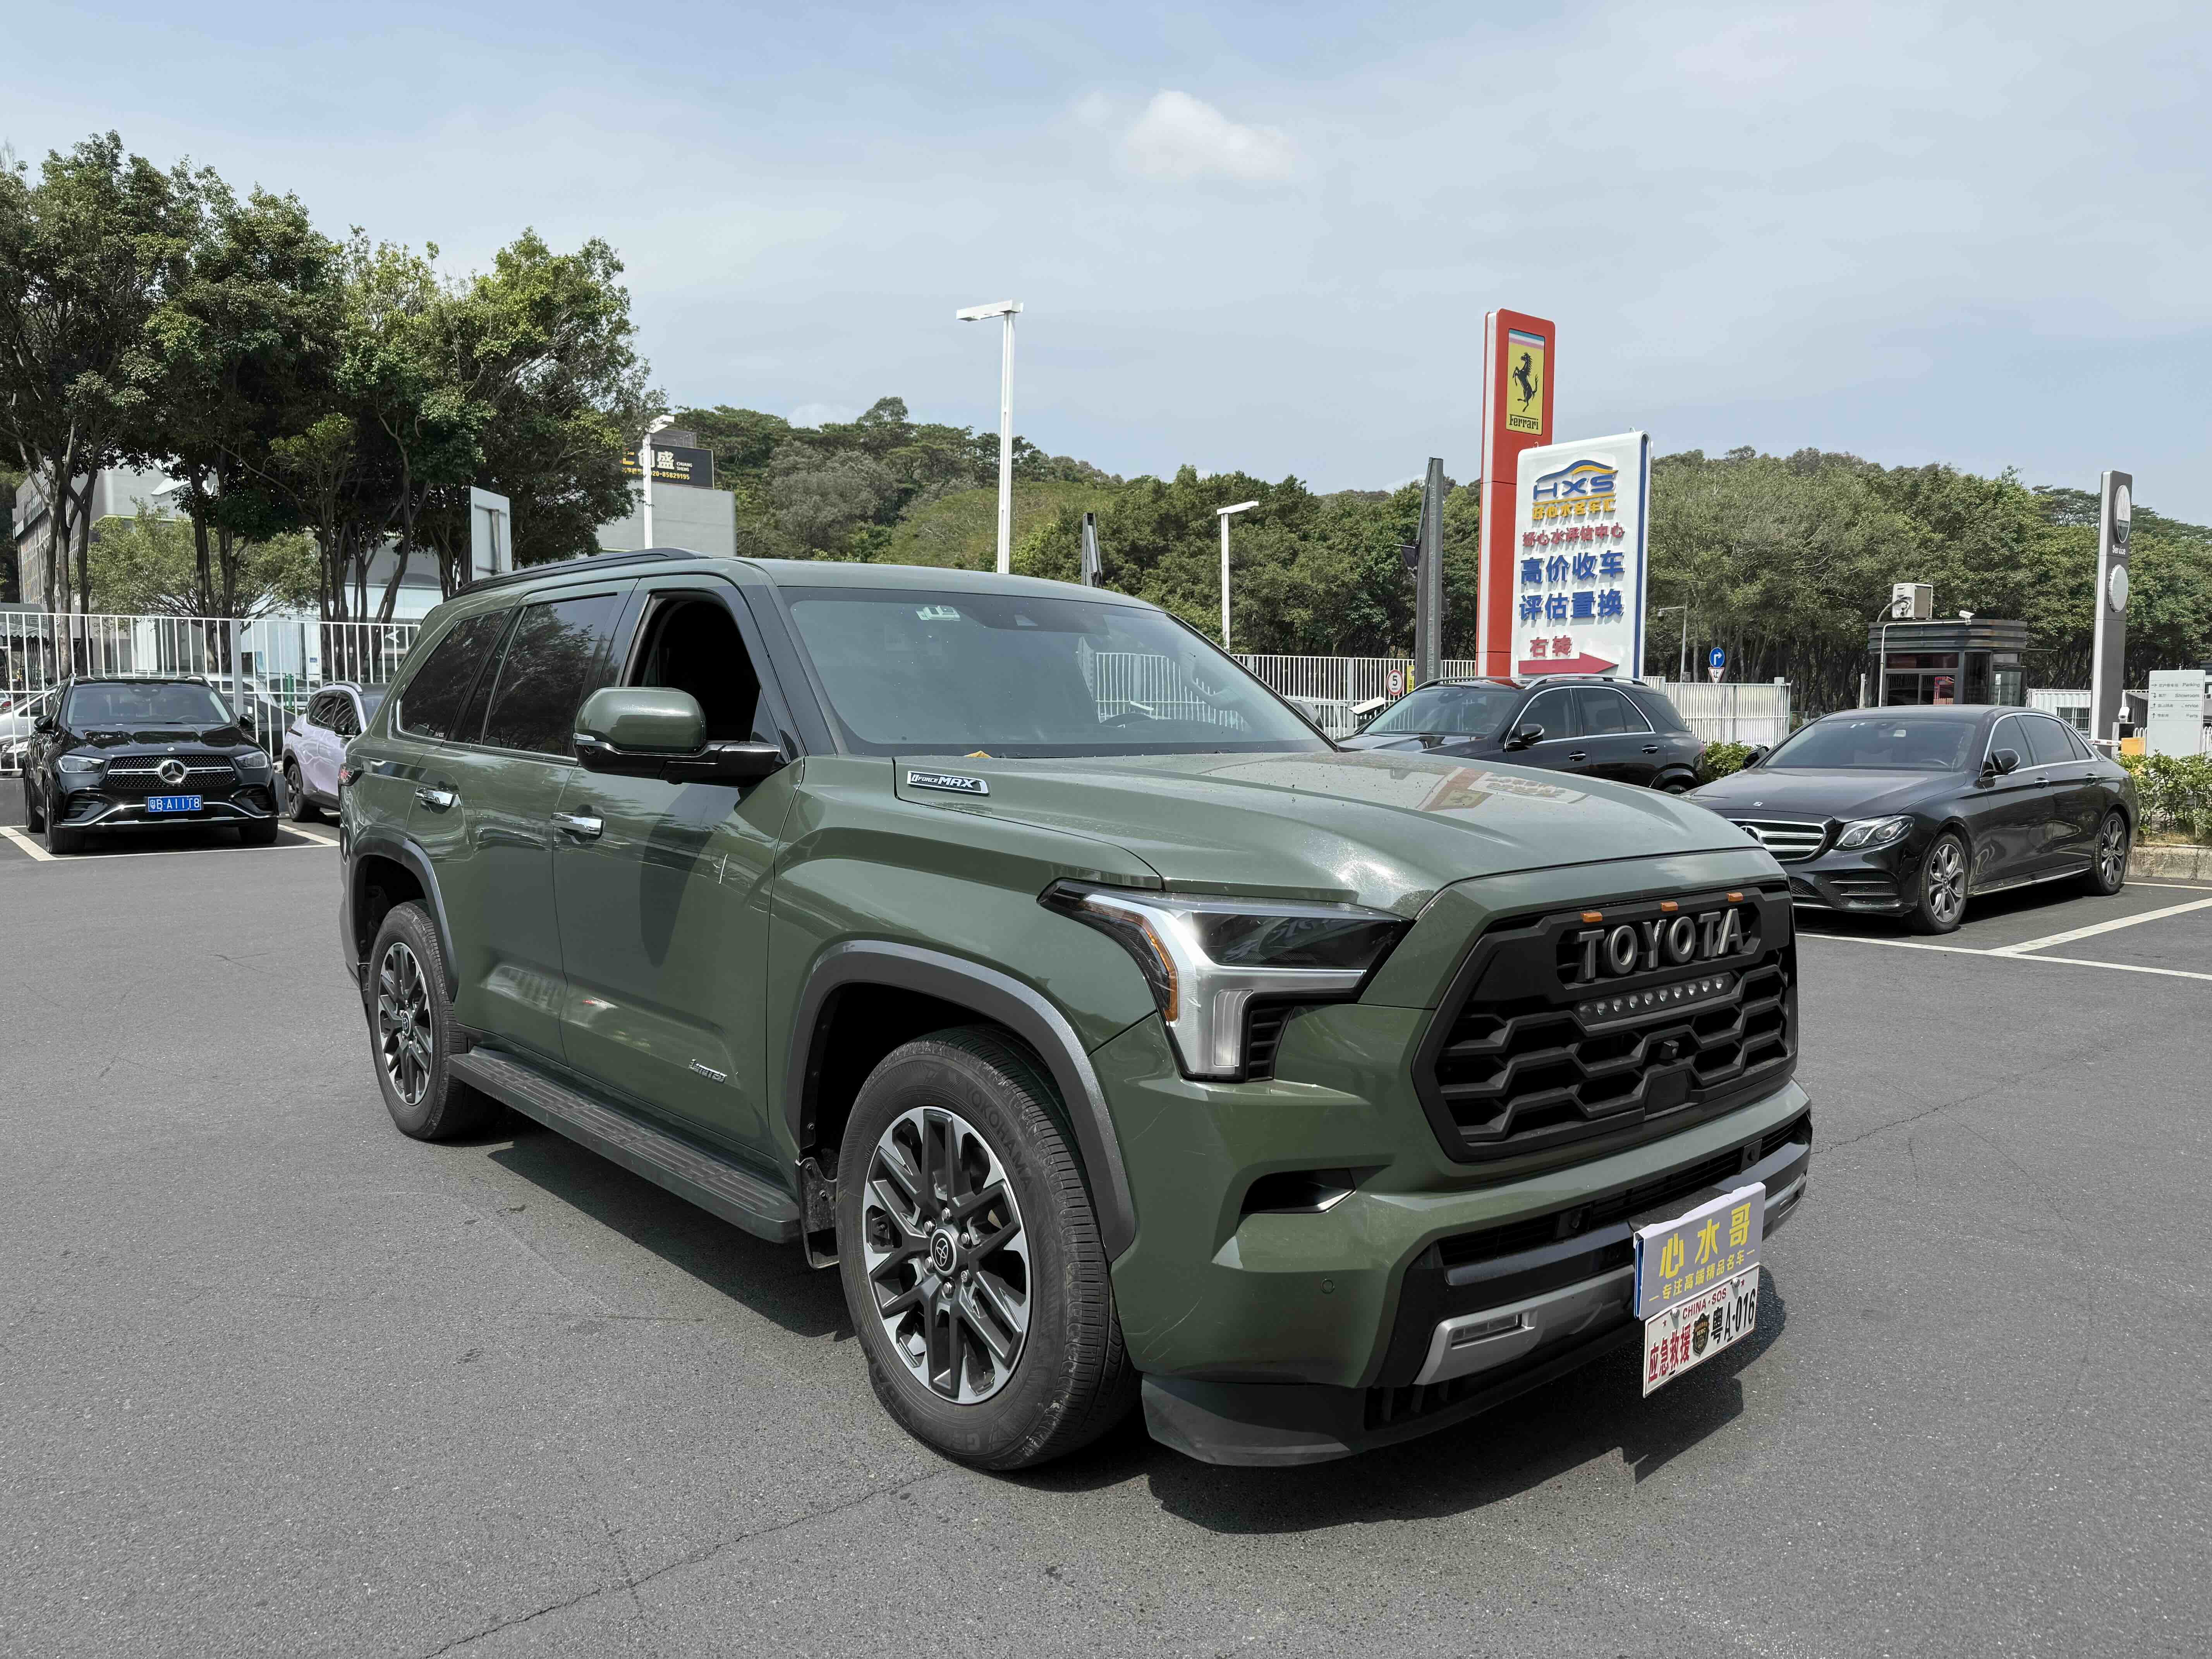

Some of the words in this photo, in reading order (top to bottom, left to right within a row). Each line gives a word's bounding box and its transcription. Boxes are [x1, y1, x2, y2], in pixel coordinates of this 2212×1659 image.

[1509, 414, 1539, 430] Ferrari
[1533, 474, 1615, 500] HXS
[1532, 499, 1616, 520] 好心水名车汇
[1523, 522, 1625, 547] 好心水评估中心
[2112, 544, 2126, 555] Service
[1520, 550, 1625, 584] 高价收车
[1519, 589, 1625, 620] 评估置换
[1530, 635, 1572, 658] 右转
[1392, 675, 1398, 686] 5
[1576, 908, 1744, 982] TOYOTA
[1659, 1202, 1751, 1279] 心水哥
[1648, 1322, 1691, 1384] 应急救援
